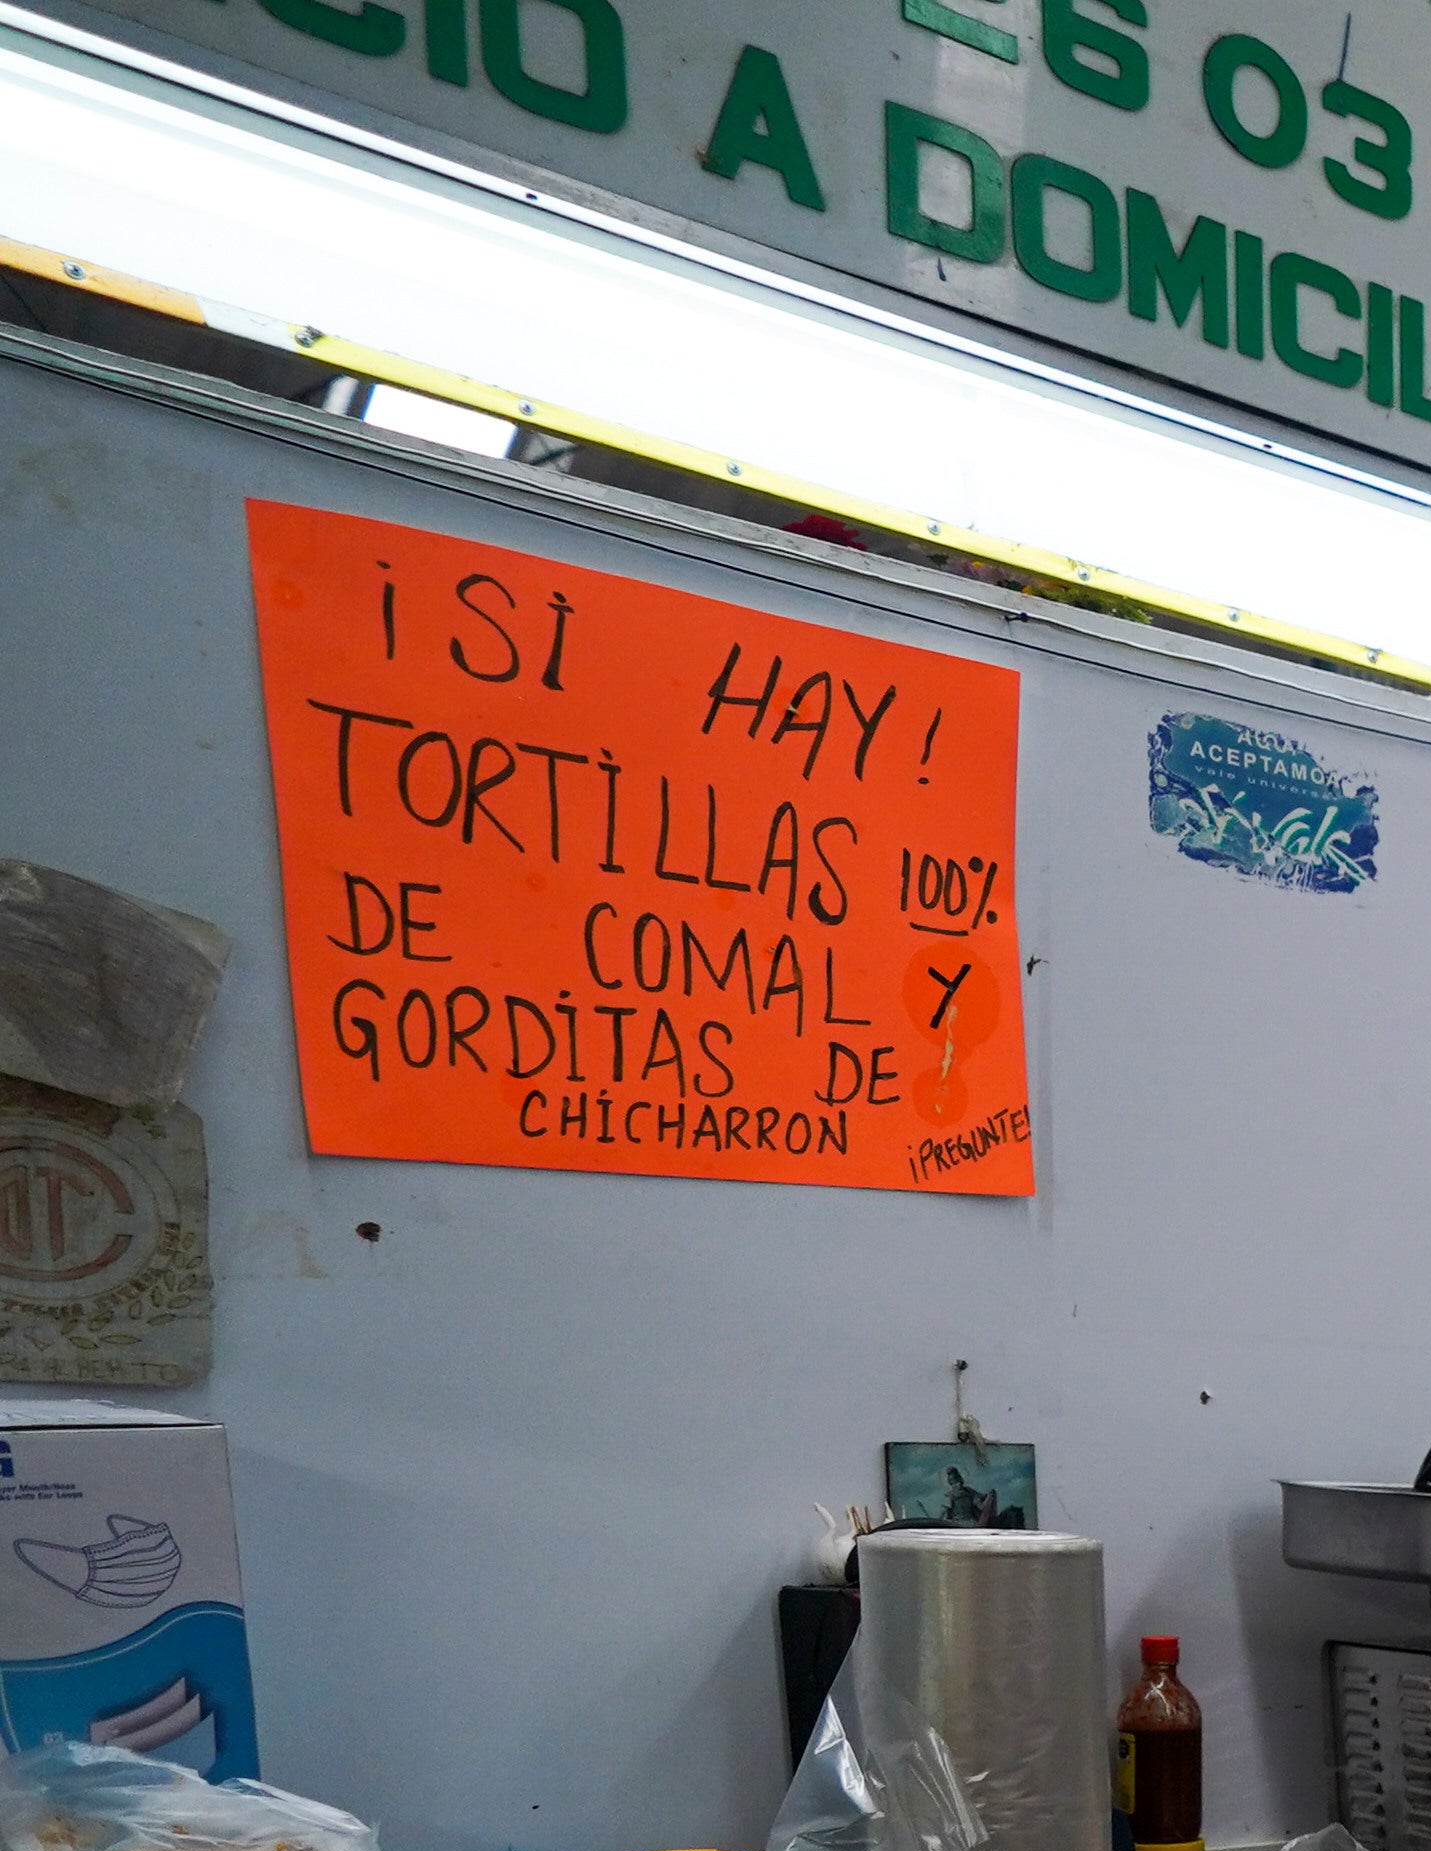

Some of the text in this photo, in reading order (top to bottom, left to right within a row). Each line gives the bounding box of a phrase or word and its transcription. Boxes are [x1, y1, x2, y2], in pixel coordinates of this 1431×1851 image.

[703, 45, 826, 211] A
[307, 698, 1000, 931] TORTILLAS 100%
[326, 872, 972, 1037] DE COMAL Y
[333, 979, 901, 1106] GORDITAS DE
[520, 1088, 848, 1156] CHICHARRON
